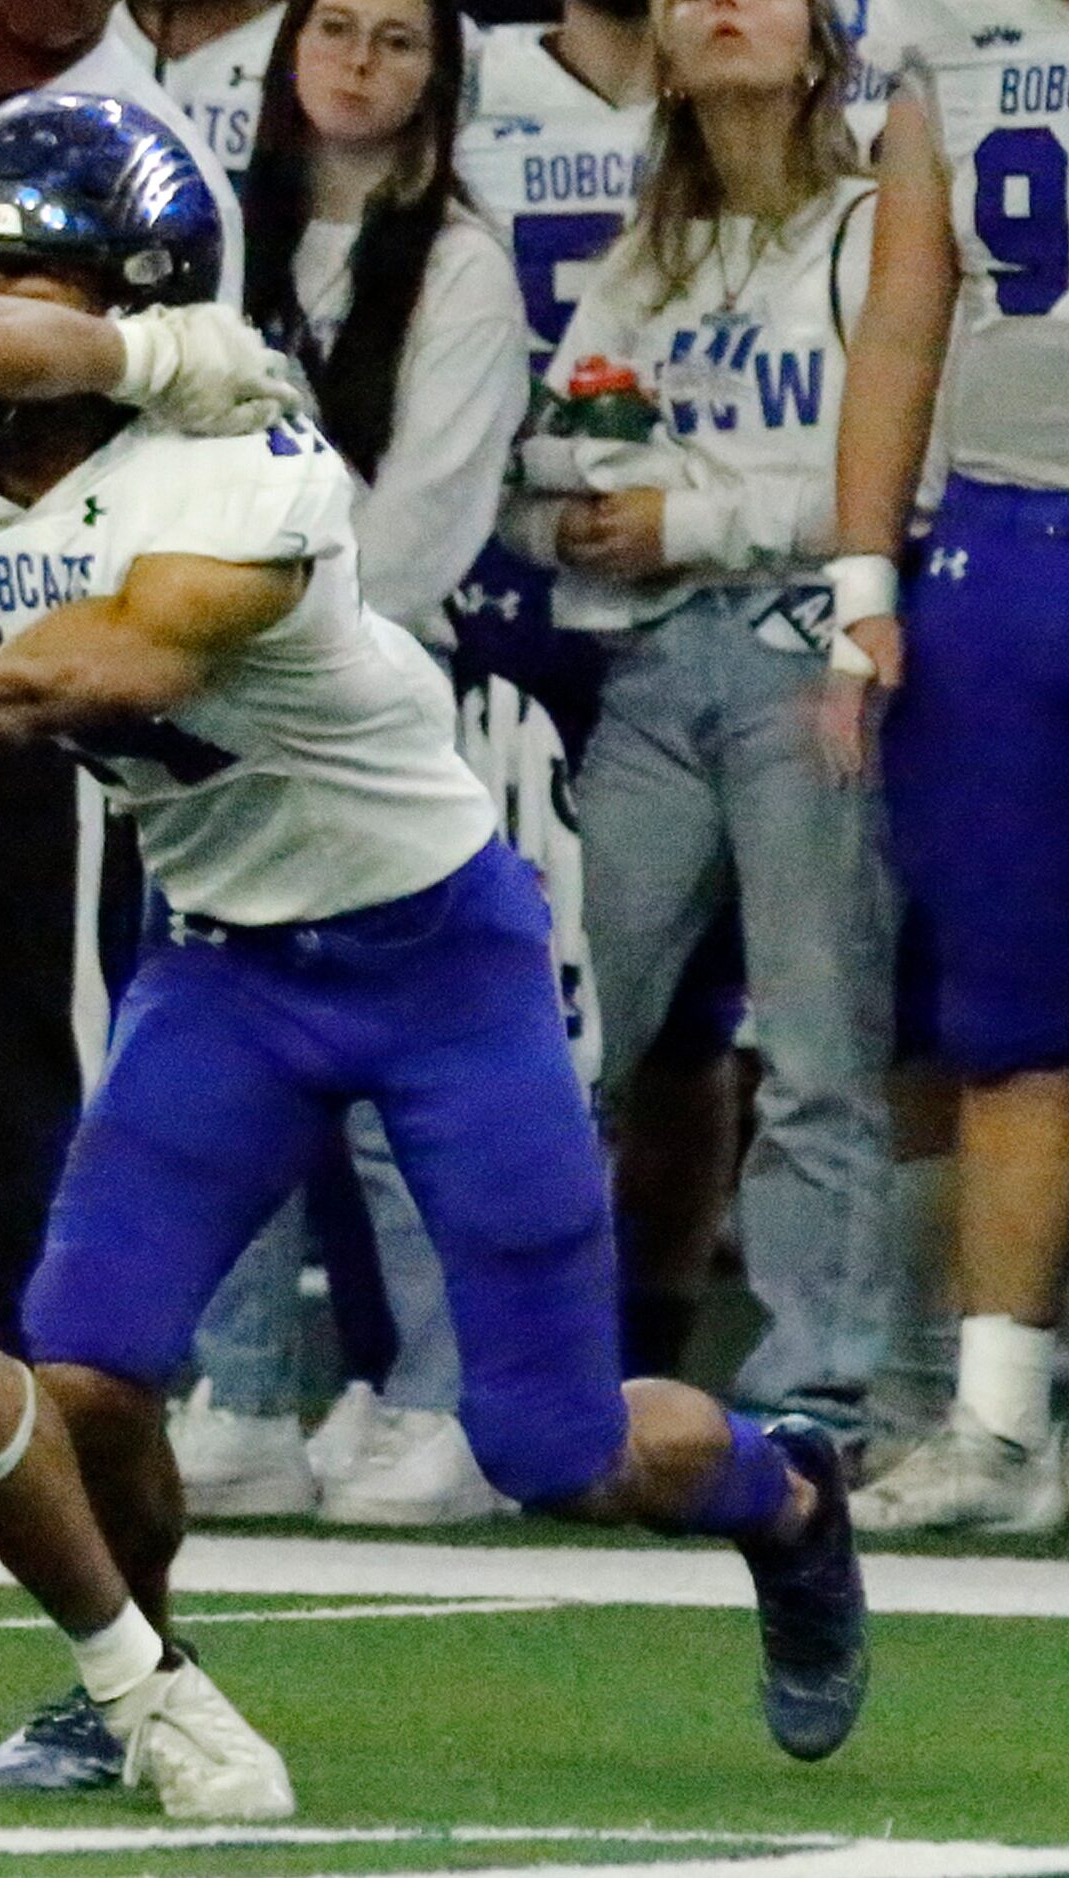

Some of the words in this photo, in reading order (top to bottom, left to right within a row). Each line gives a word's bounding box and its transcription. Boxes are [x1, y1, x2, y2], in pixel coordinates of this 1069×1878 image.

[999, 64, 1069, 115] BOB
[183, 104, 250, 155] TS
[974, 125, 1069, 317] 9
